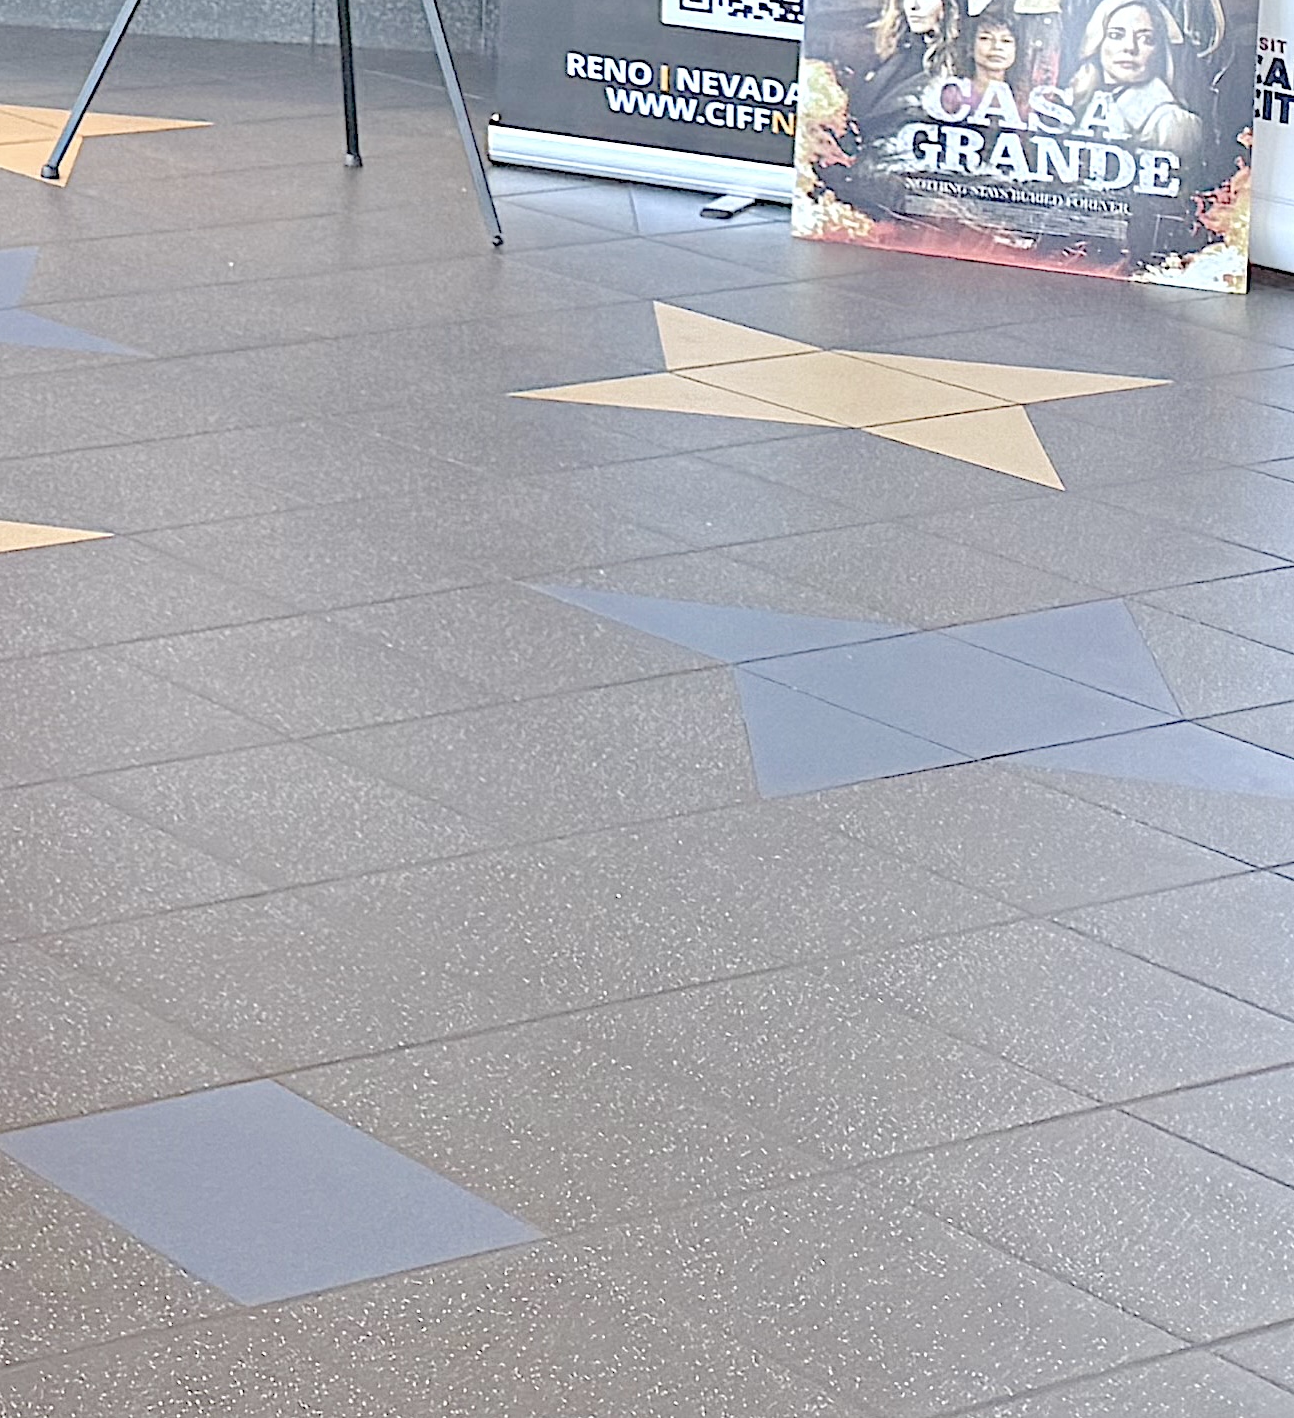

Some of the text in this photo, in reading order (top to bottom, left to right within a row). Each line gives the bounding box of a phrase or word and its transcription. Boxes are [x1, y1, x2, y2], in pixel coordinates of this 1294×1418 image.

[566, 52, 799, 106] RENO NEVADA
[606, 87, 795, 136] WWW.CIFFN
[923, 76, 1131, 141] CASA
[902, 122, 1182, 198] GRANDE
[905, 178, 967, 196] NOTHING
[970, 184, 1009, 202] STAYS
[1012, 188, 1063, 207] BURIED
